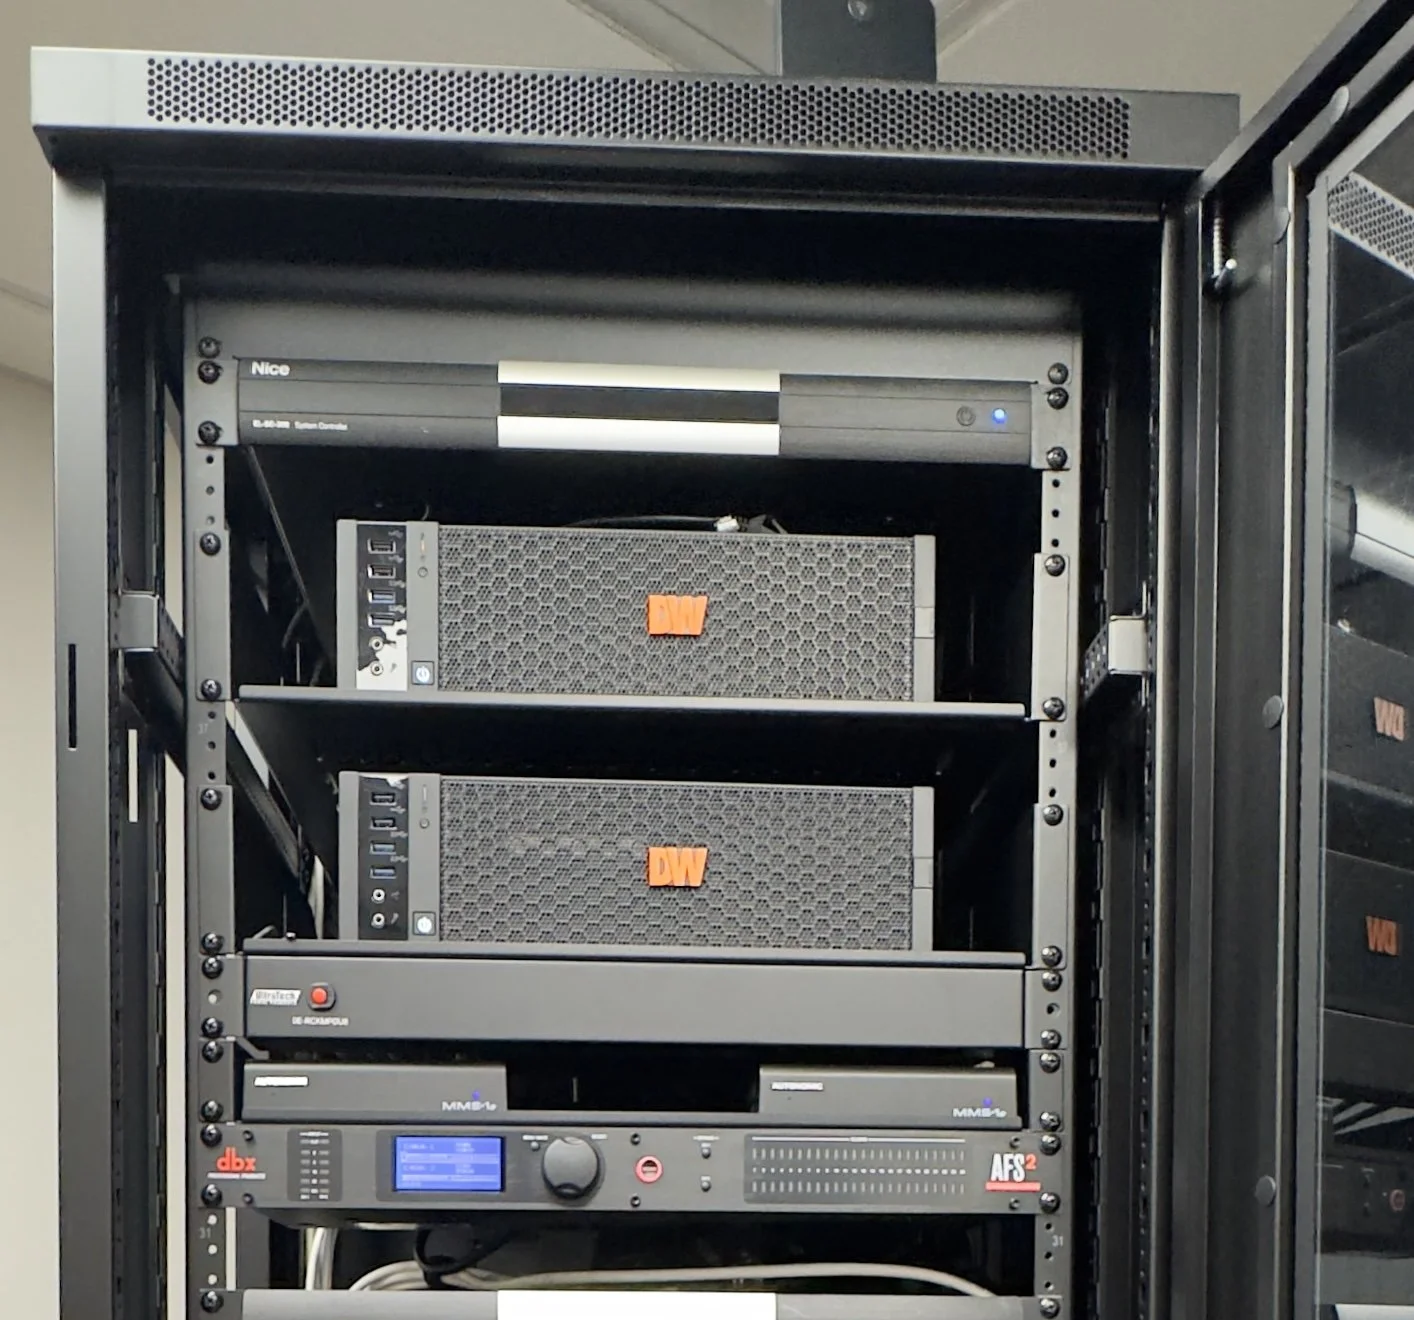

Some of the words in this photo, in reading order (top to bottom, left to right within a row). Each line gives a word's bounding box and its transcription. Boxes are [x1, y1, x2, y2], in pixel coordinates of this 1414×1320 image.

[251, 361, 290, 376] Nice
[648, 594, 708, 635] DW
[648, 846, 708, 887] DW
[216, 1146, 257, 1172] dbx
[1052, 1235, 1064, 1247] 31
